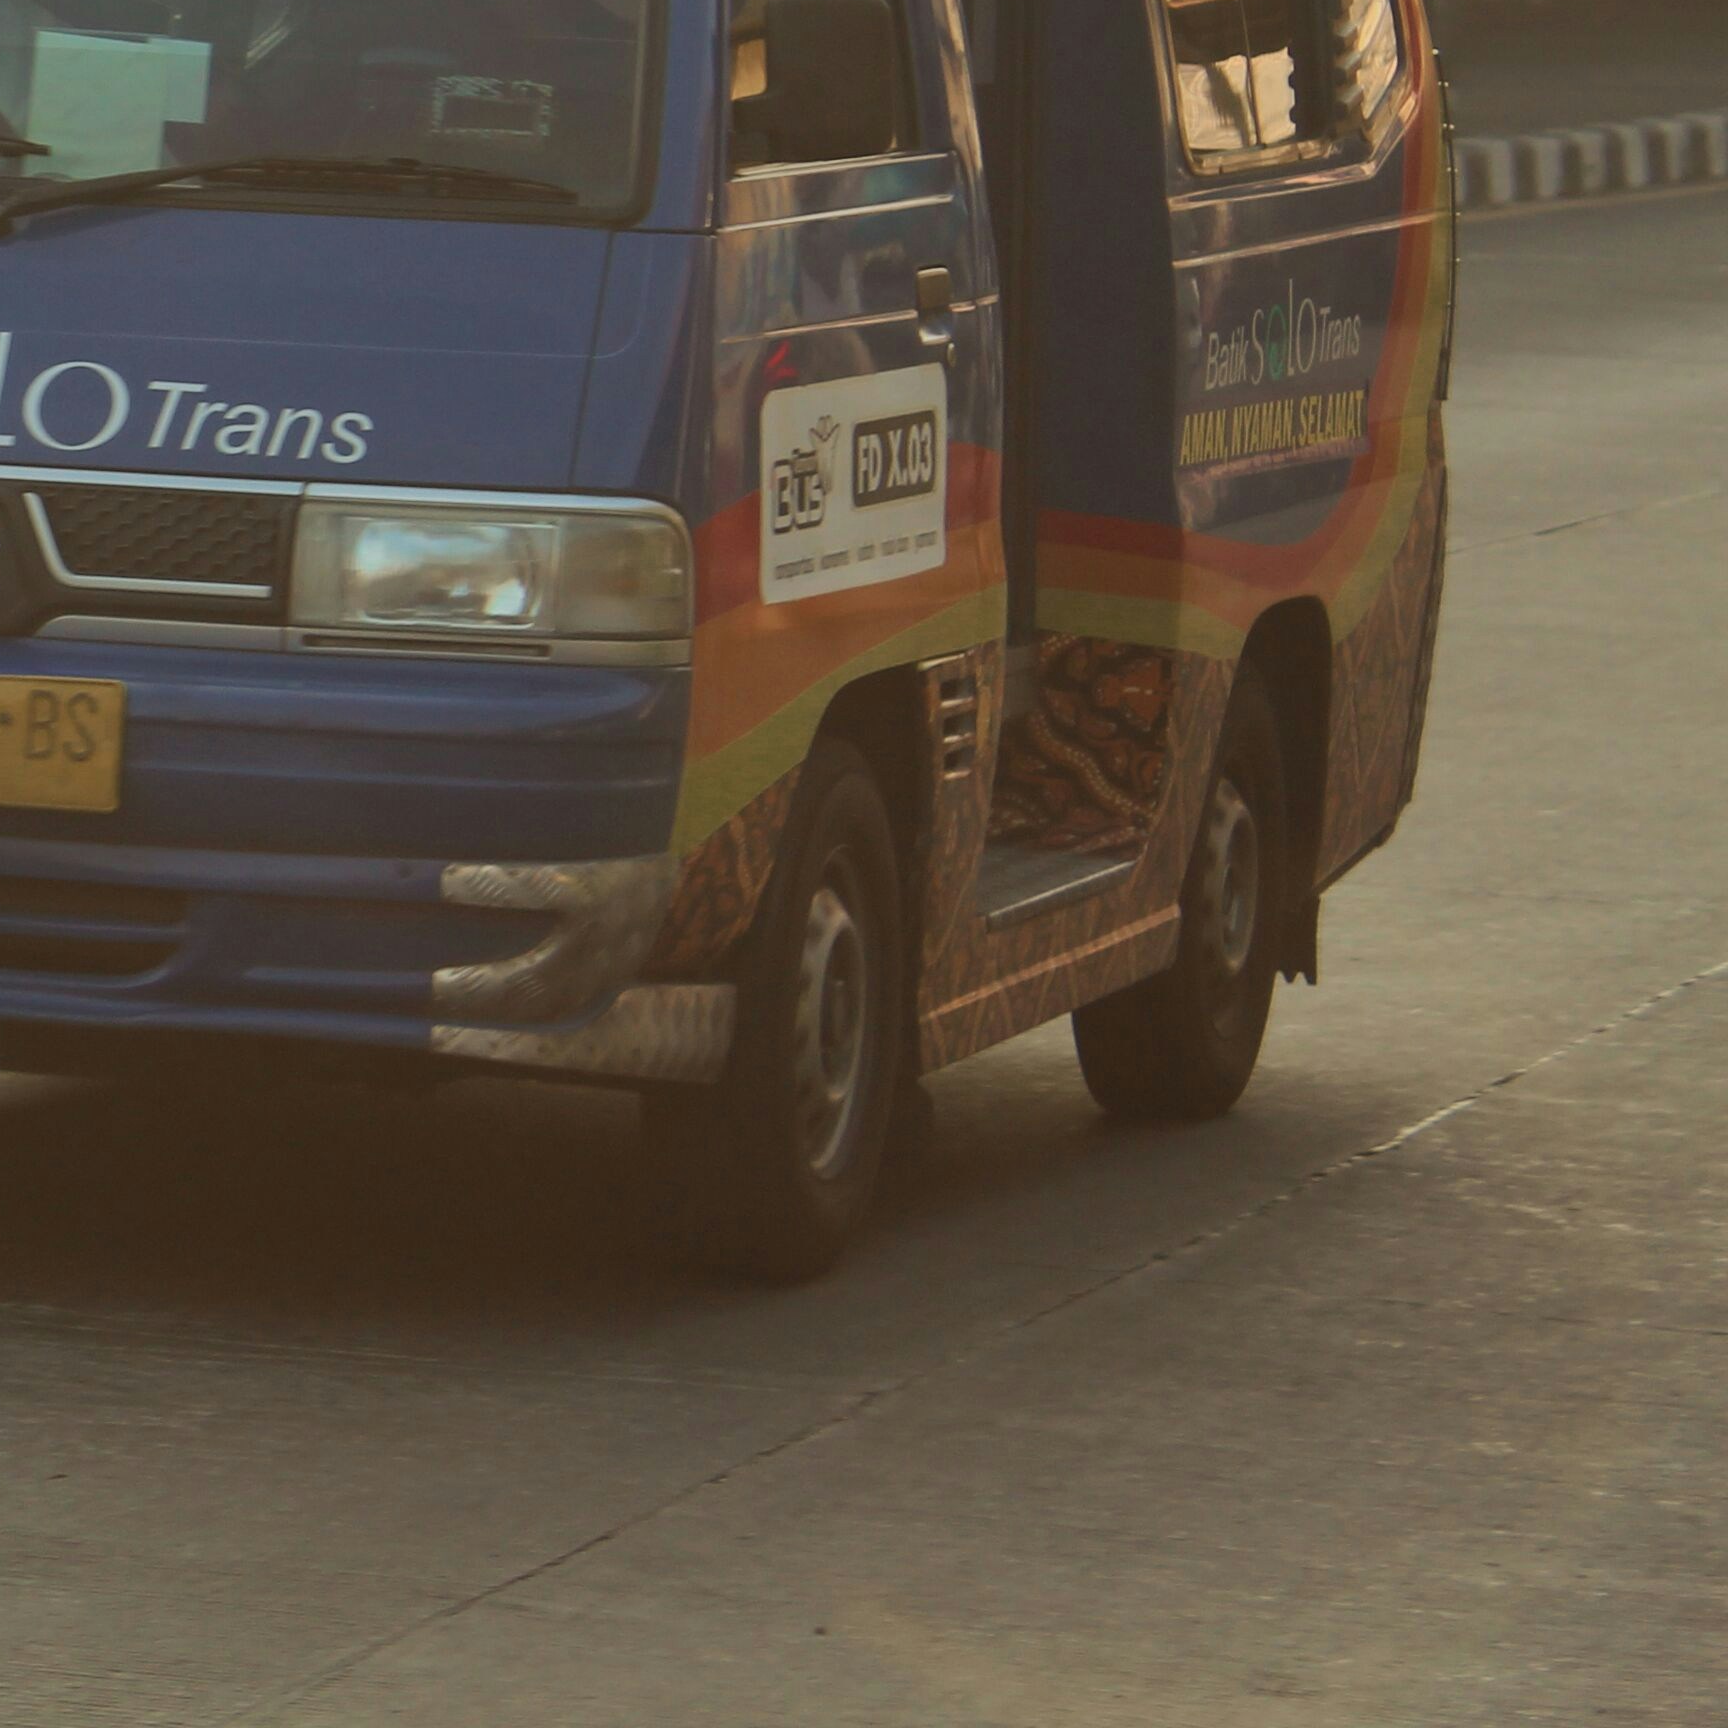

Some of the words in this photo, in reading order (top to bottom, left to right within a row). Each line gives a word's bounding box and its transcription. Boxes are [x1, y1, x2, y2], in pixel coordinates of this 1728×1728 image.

[1205, 325, 1248, 392] Batik
[1319, 306, 1361, 362] Trans
[145, 380, 374, 464] Trans
[1297, 389, 1365, 447] SELAMAT
[857, 433, 882, 494] FD
[886, 422, 933, 488] X.03
[23, 687, 101, 764] BS
